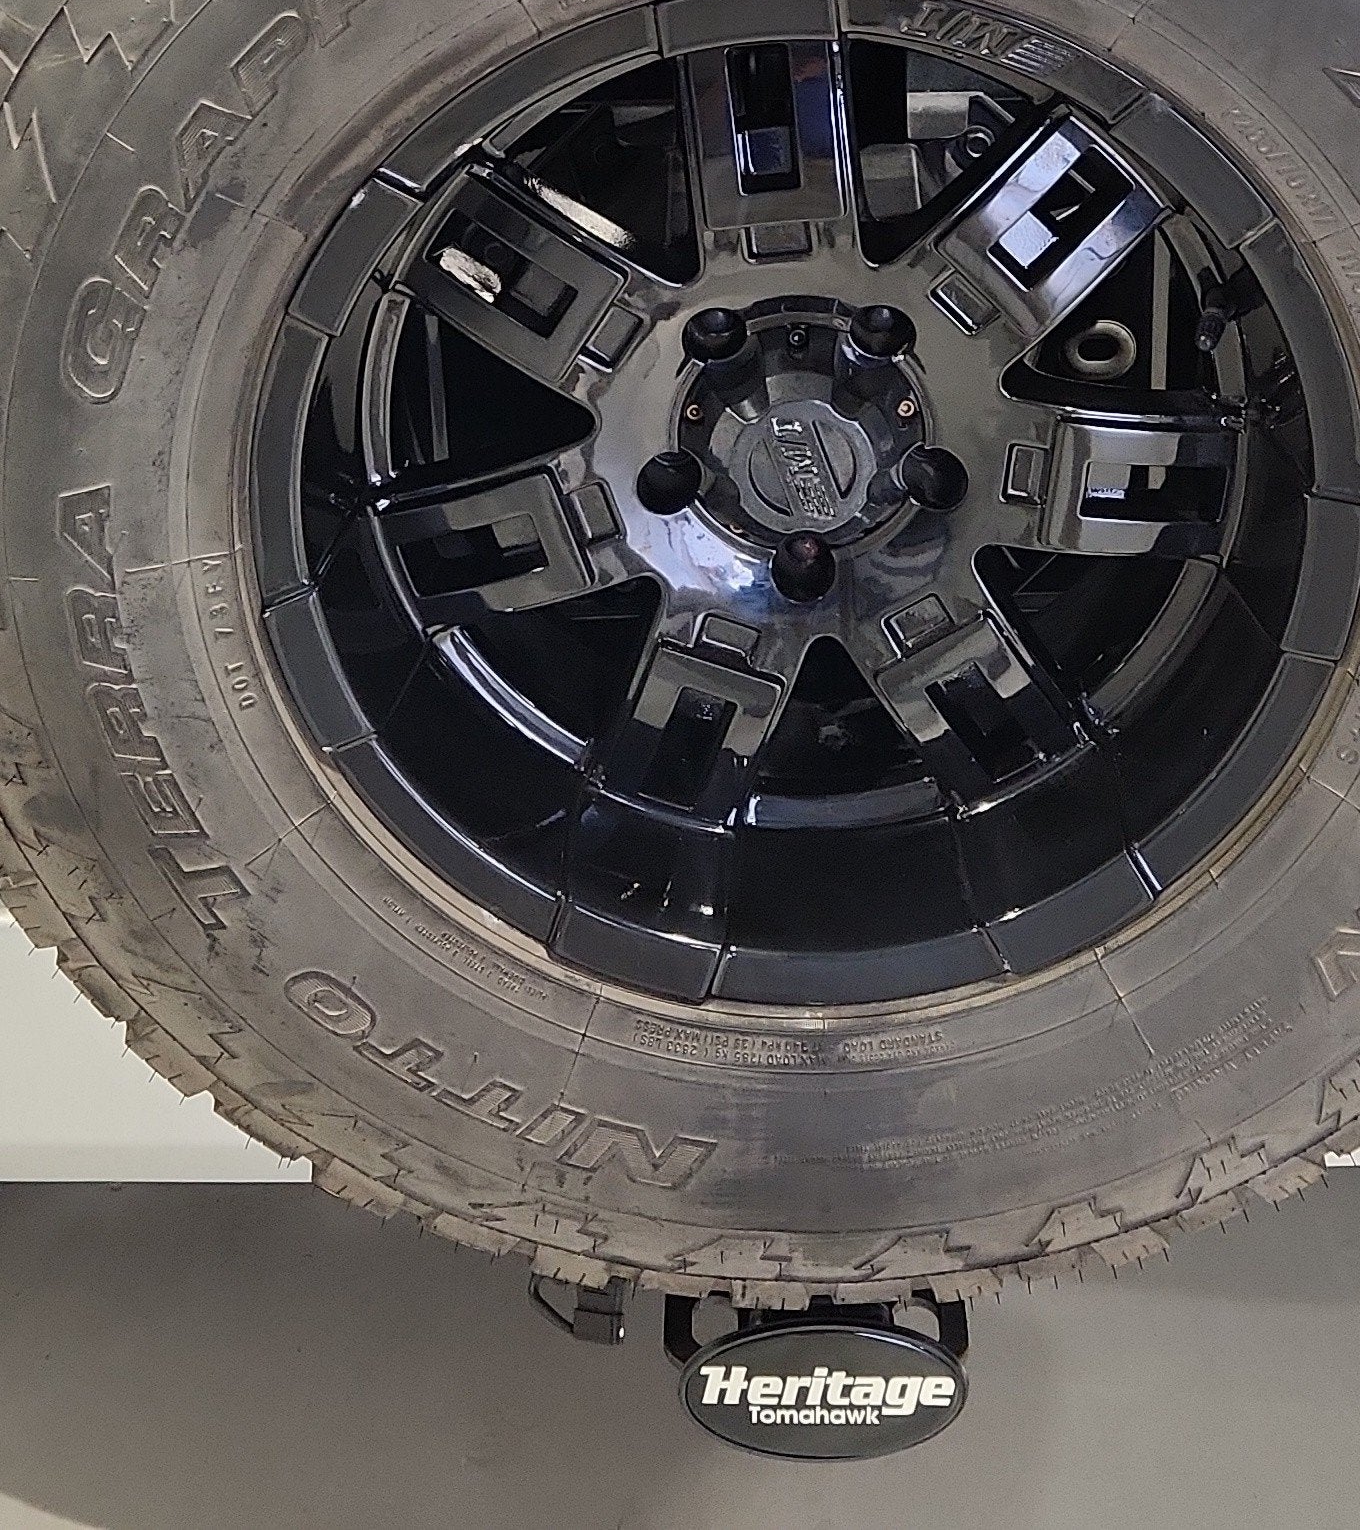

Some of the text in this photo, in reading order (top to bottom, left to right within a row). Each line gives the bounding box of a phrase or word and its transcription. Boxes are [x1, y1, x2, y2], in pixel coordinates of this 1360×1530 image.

[56, 484, 250, 933] TERRA
[224, 662, 259, 712] DOT
[283, 969, 719, 1191] NITTO
[700, 1365, 956, 1416] Heritage
[748, 1405, 881, 1425] Tomahawk
